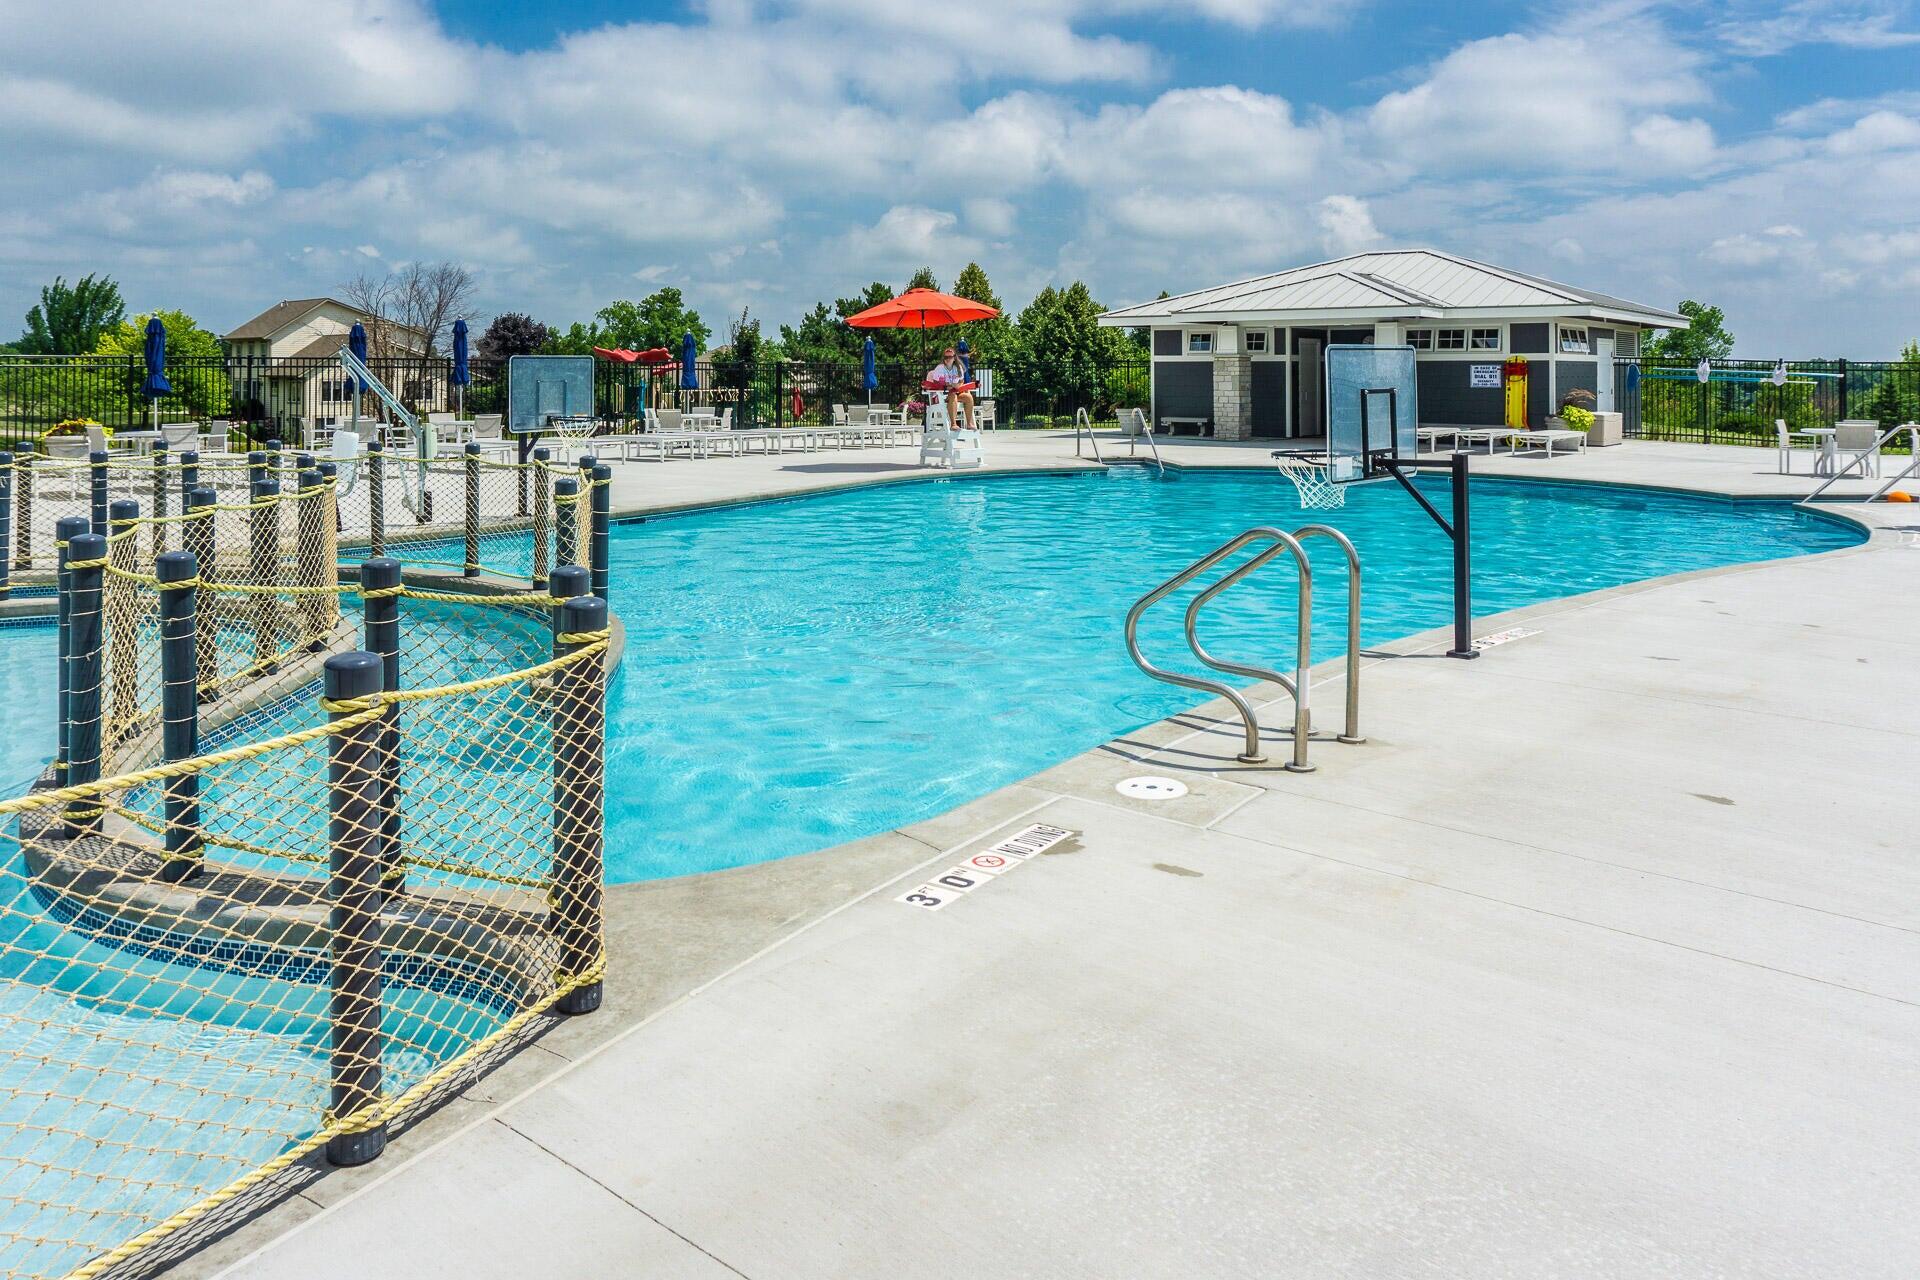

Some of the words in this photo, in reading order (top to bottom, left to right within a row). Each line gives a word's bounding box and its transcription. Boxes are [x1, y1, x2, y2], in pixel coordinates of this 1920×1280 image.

[1012, 826, 1066, 848] DIVING
[997, 844, 1034, 857] NO
[906, 894, 942, 906] 3
[939, 875, 975, 888] 0
